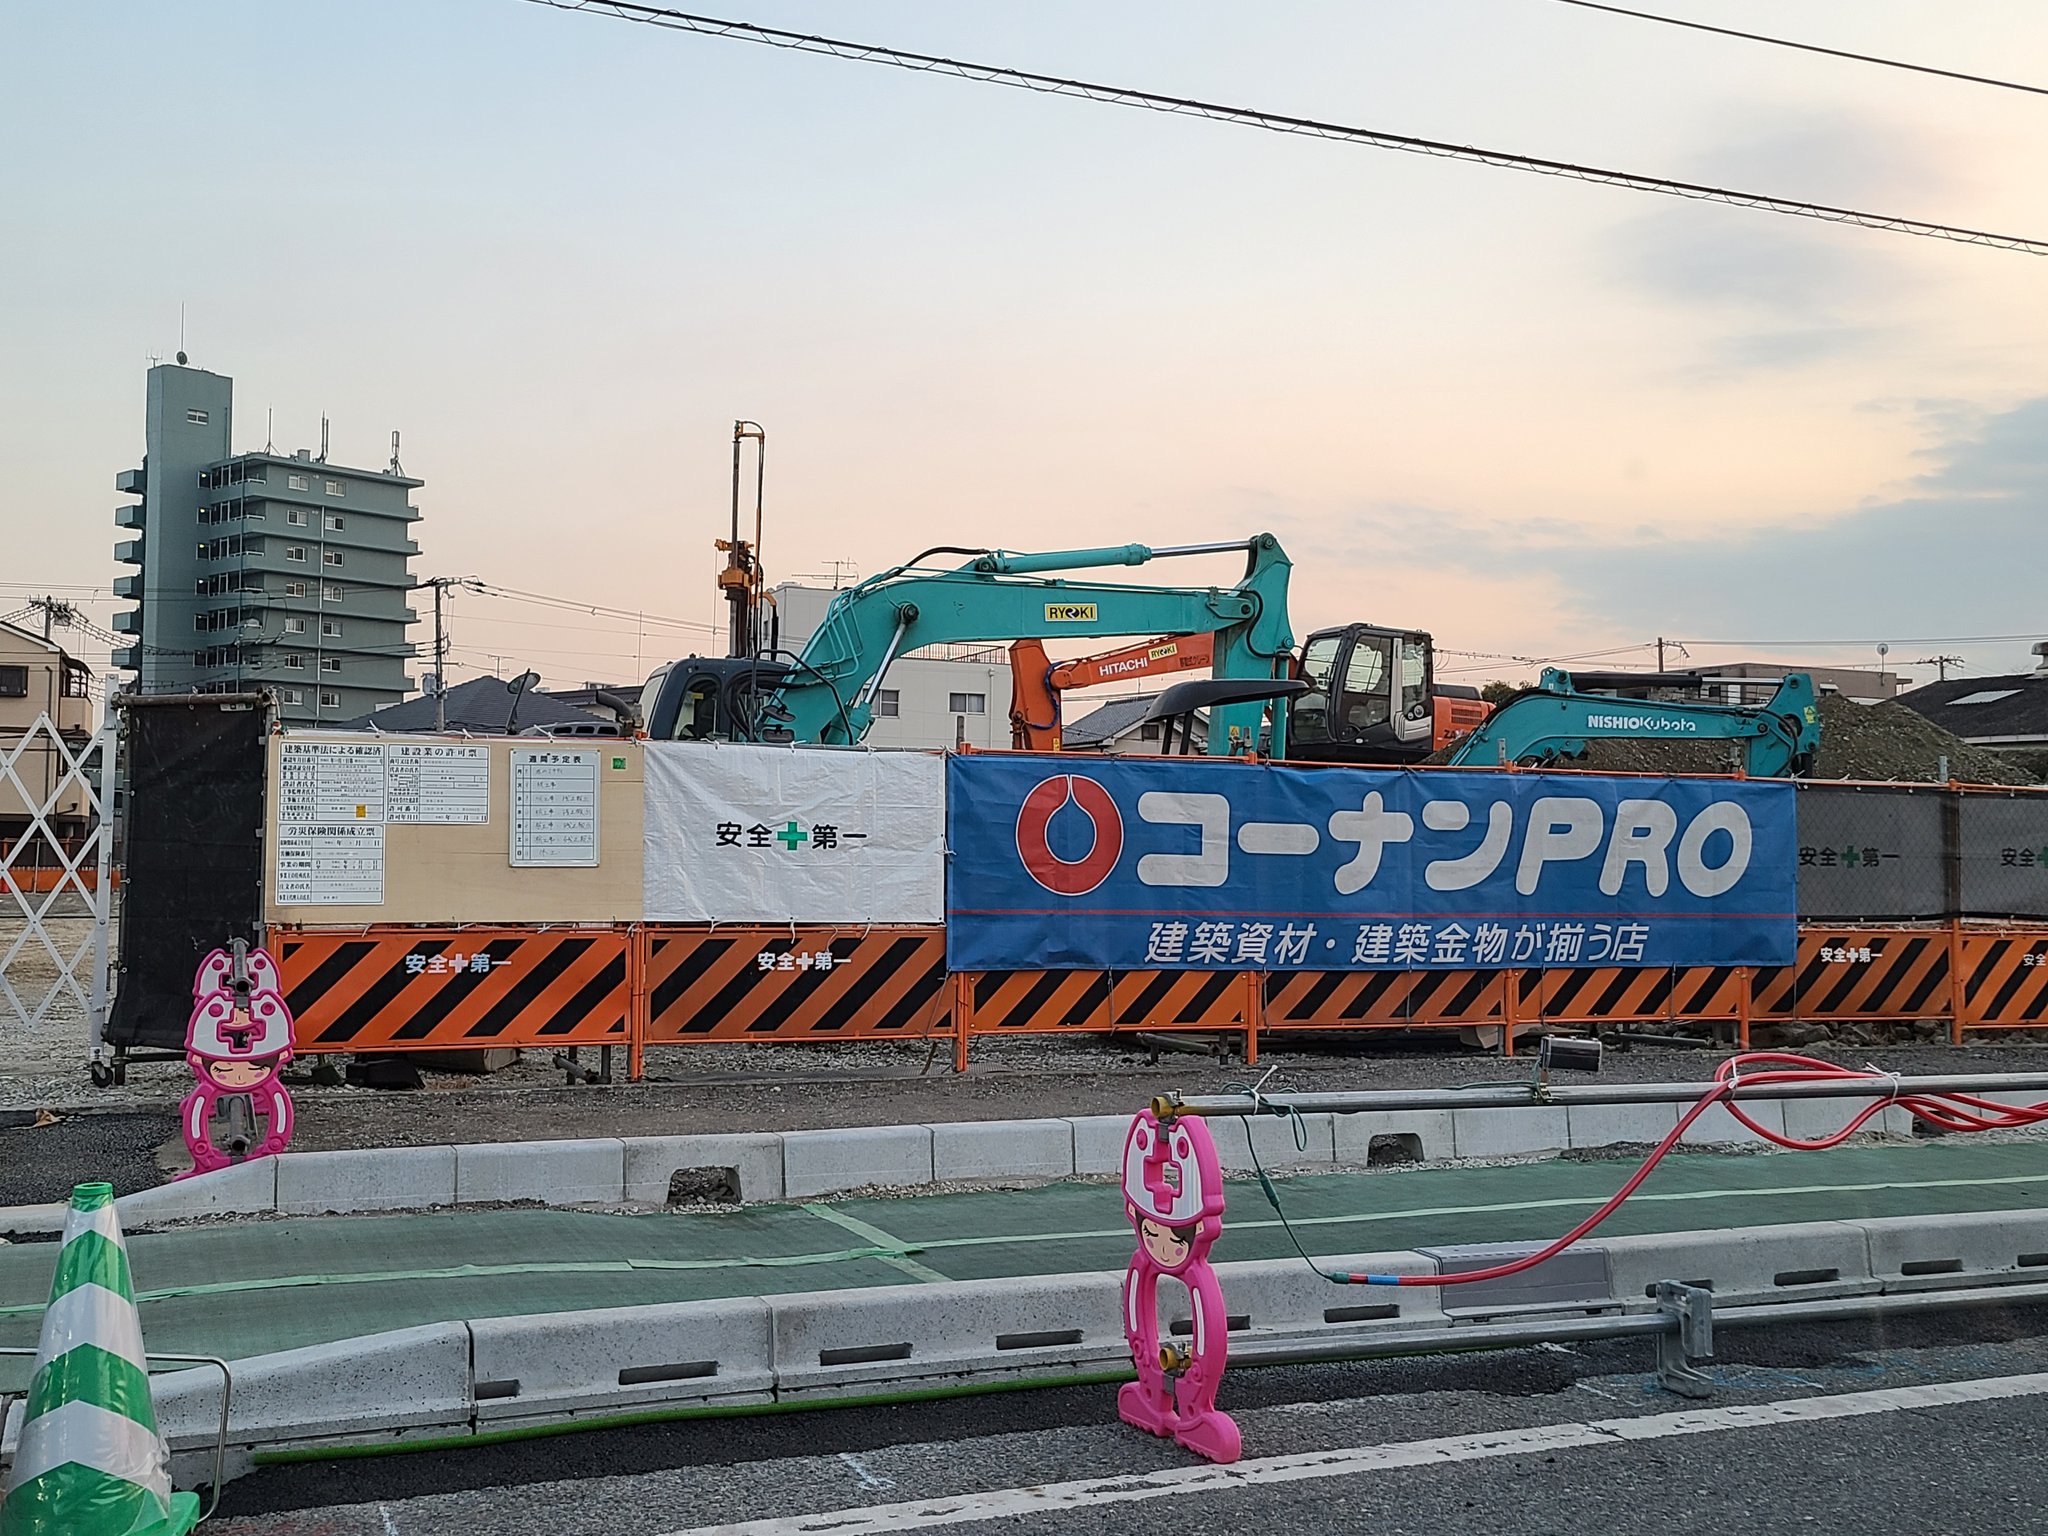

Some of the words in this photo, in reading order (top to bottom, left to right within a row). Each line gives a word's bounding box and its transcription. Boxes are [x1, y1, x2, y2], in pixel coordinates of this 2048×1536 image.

[1099, 657, 1148, 677] HITACHI
[1587, 715, 1640, 730] NISHIO
[1640, 716, 1697, 732] Kubota
[284, 744, 381, 756] 建築基準法による確認済
[401, 746, 477, 757] 建設業の許可票
[287, 826, 375, 836] 労災保険関係成立票
[716, 821, 773, 848] 安全
[811, 824, 867, 849] 第一
[1137, 791, 1753, 898] コーナンPRO
[1798, 846, 1838, 868] 安全
[1861, 847, 1900, 868] 第一
[2001, 848, 2036, 868] 安全
[405, 954, 448, 974] 安全
[470, 953, 512, 974] 第一
[757, 952, 795, 971] 安全
[814, 952, 852, 971] 第一
[1820, 947, 1846, 964] 安全
[1857, 948, 1883, 964] 第一
[2023, 953, 2048, 967] 安全
